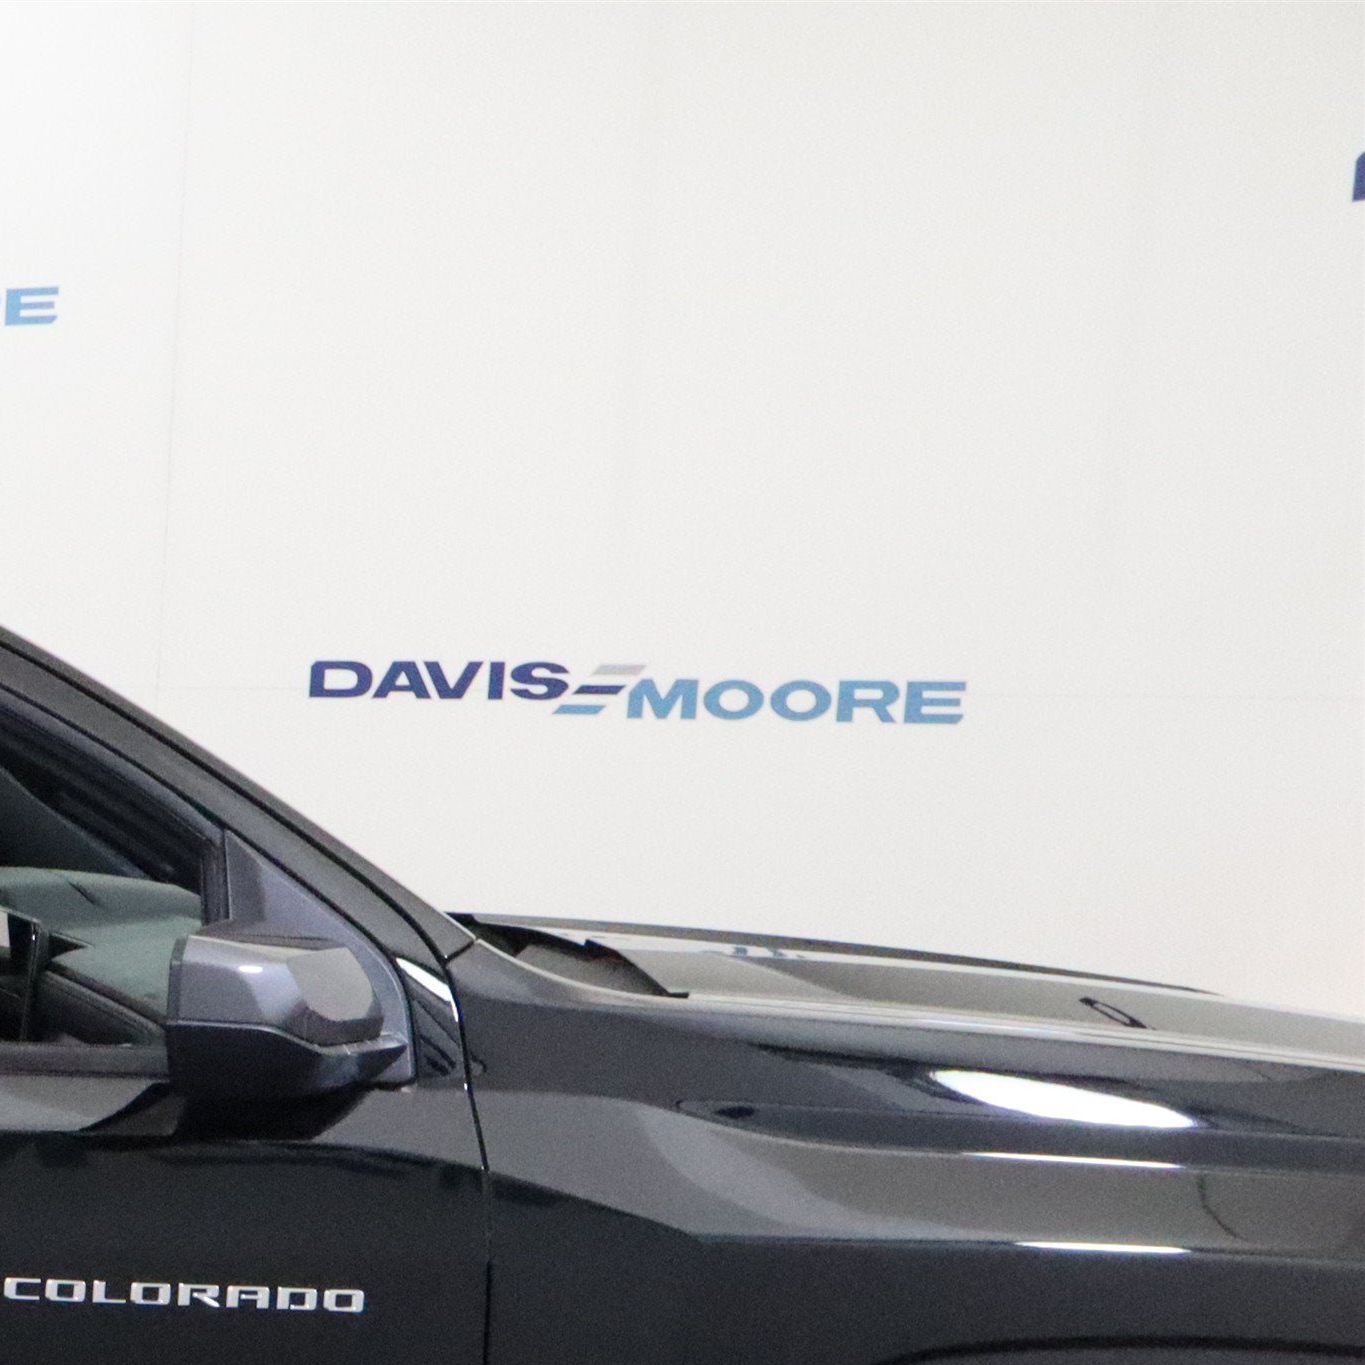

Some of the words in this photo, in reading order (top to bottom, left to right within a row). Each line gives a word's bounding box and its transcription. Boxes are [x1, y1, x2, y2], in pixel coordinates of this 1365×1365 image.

[308, 660, 571, 700] DAVIS
[626, 678, 967, 724] MOORE
[3, 1277, 365, 1313] COLORADO
